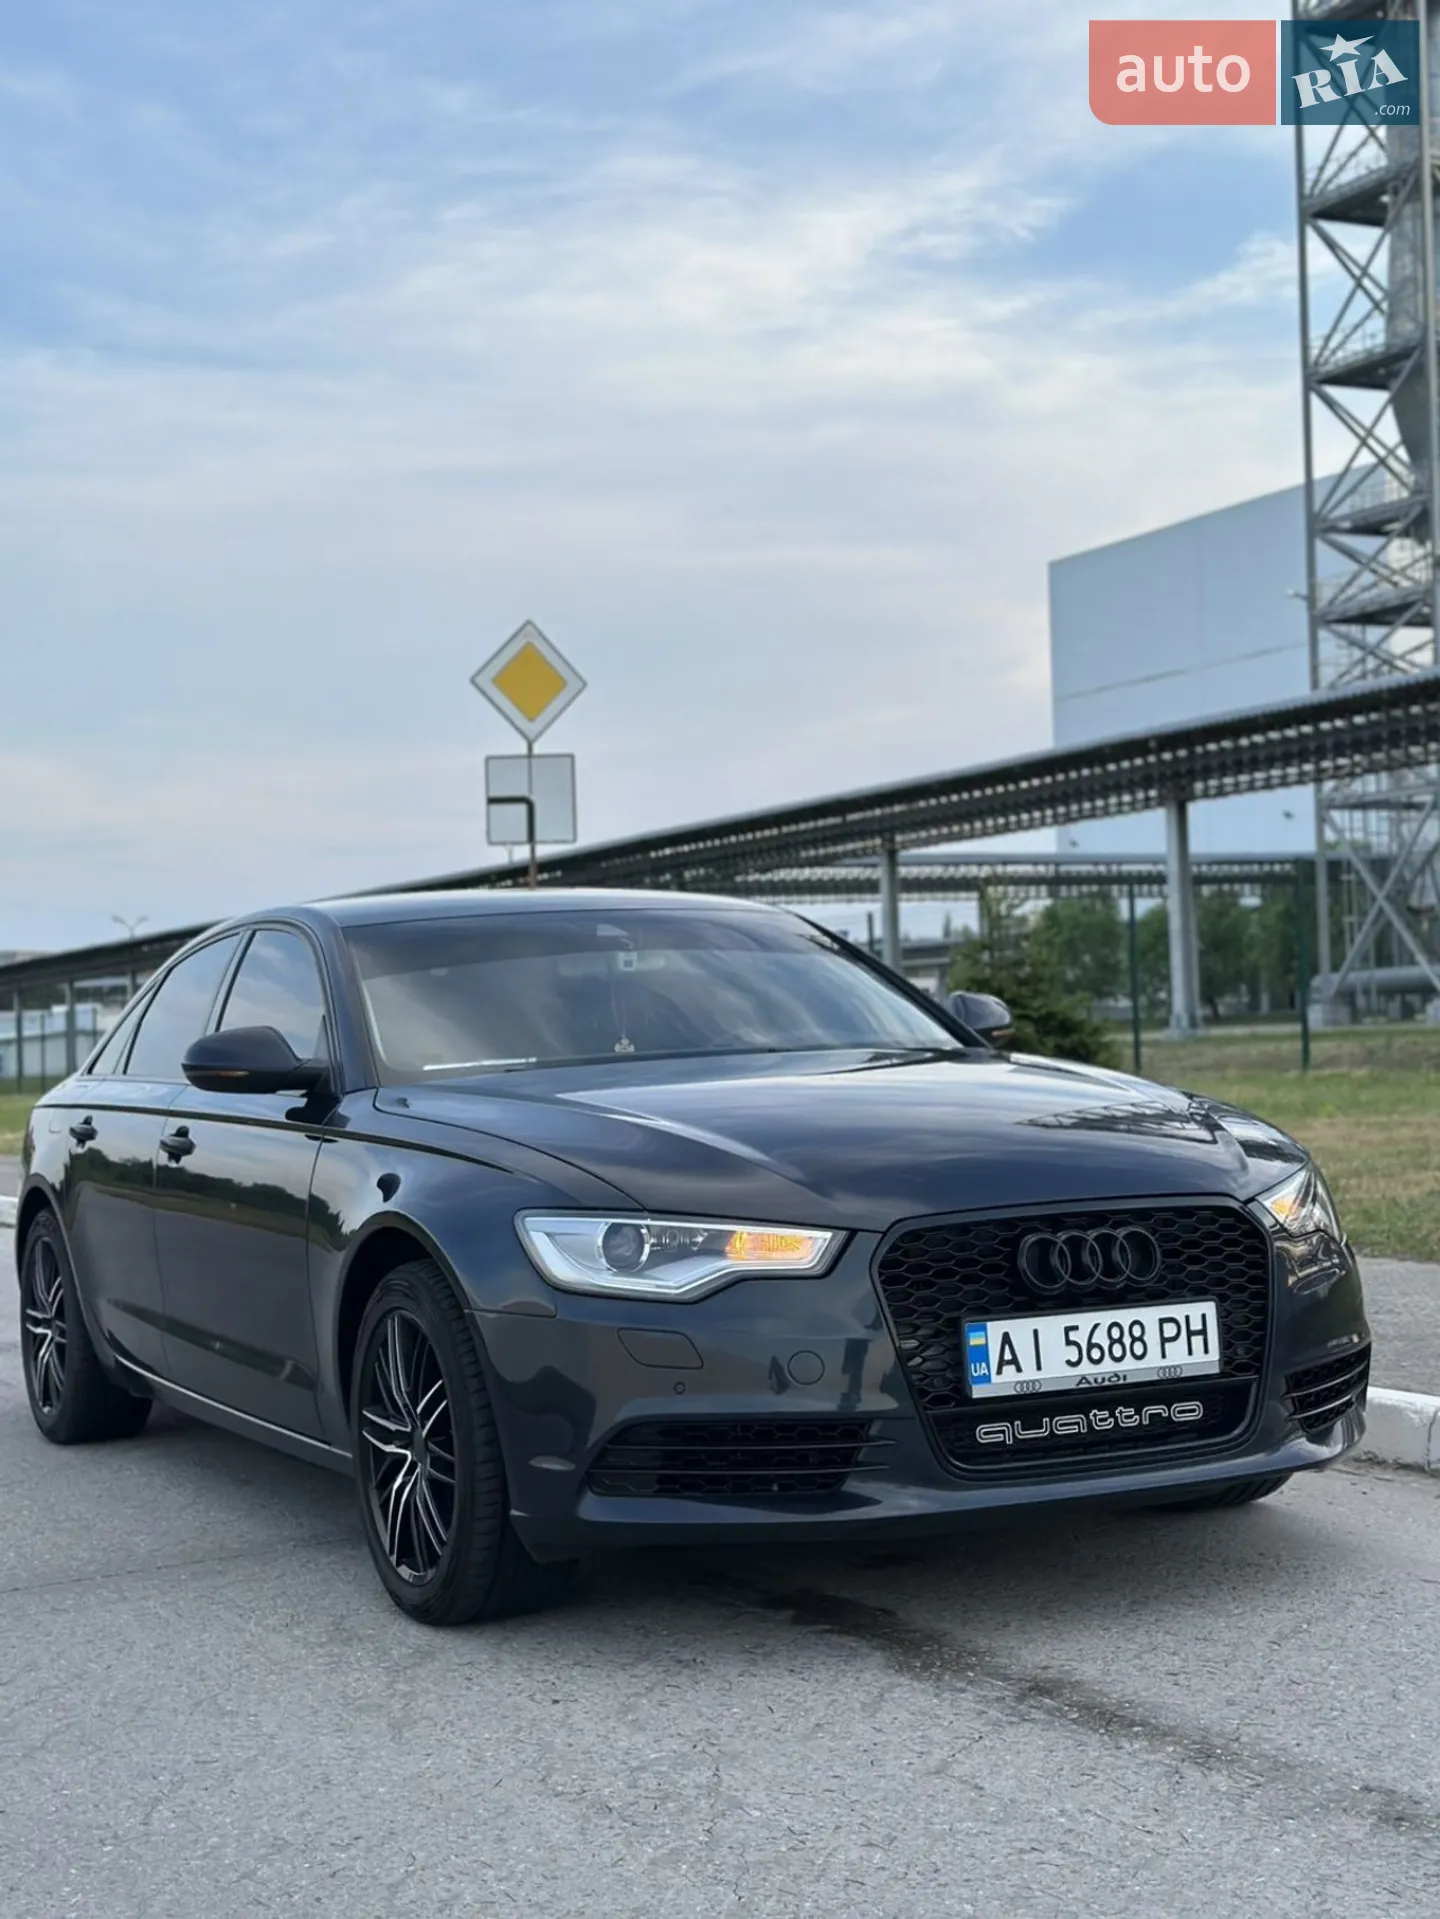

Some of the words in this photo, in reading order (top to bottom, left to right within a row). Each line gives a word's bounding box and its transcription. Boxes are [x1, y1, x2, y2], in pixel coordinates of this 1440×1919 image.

[995, 1328, 1042, 1376] AI
[1063, 1319, 1148, 1368] 5688
[1158, 1313, 1210, 1360] PH
[971, 1363, 989, 1377] UA
[1074, 1372, 1128, 1387] Audi
[975, 1401, 1204, 1445] quattro
